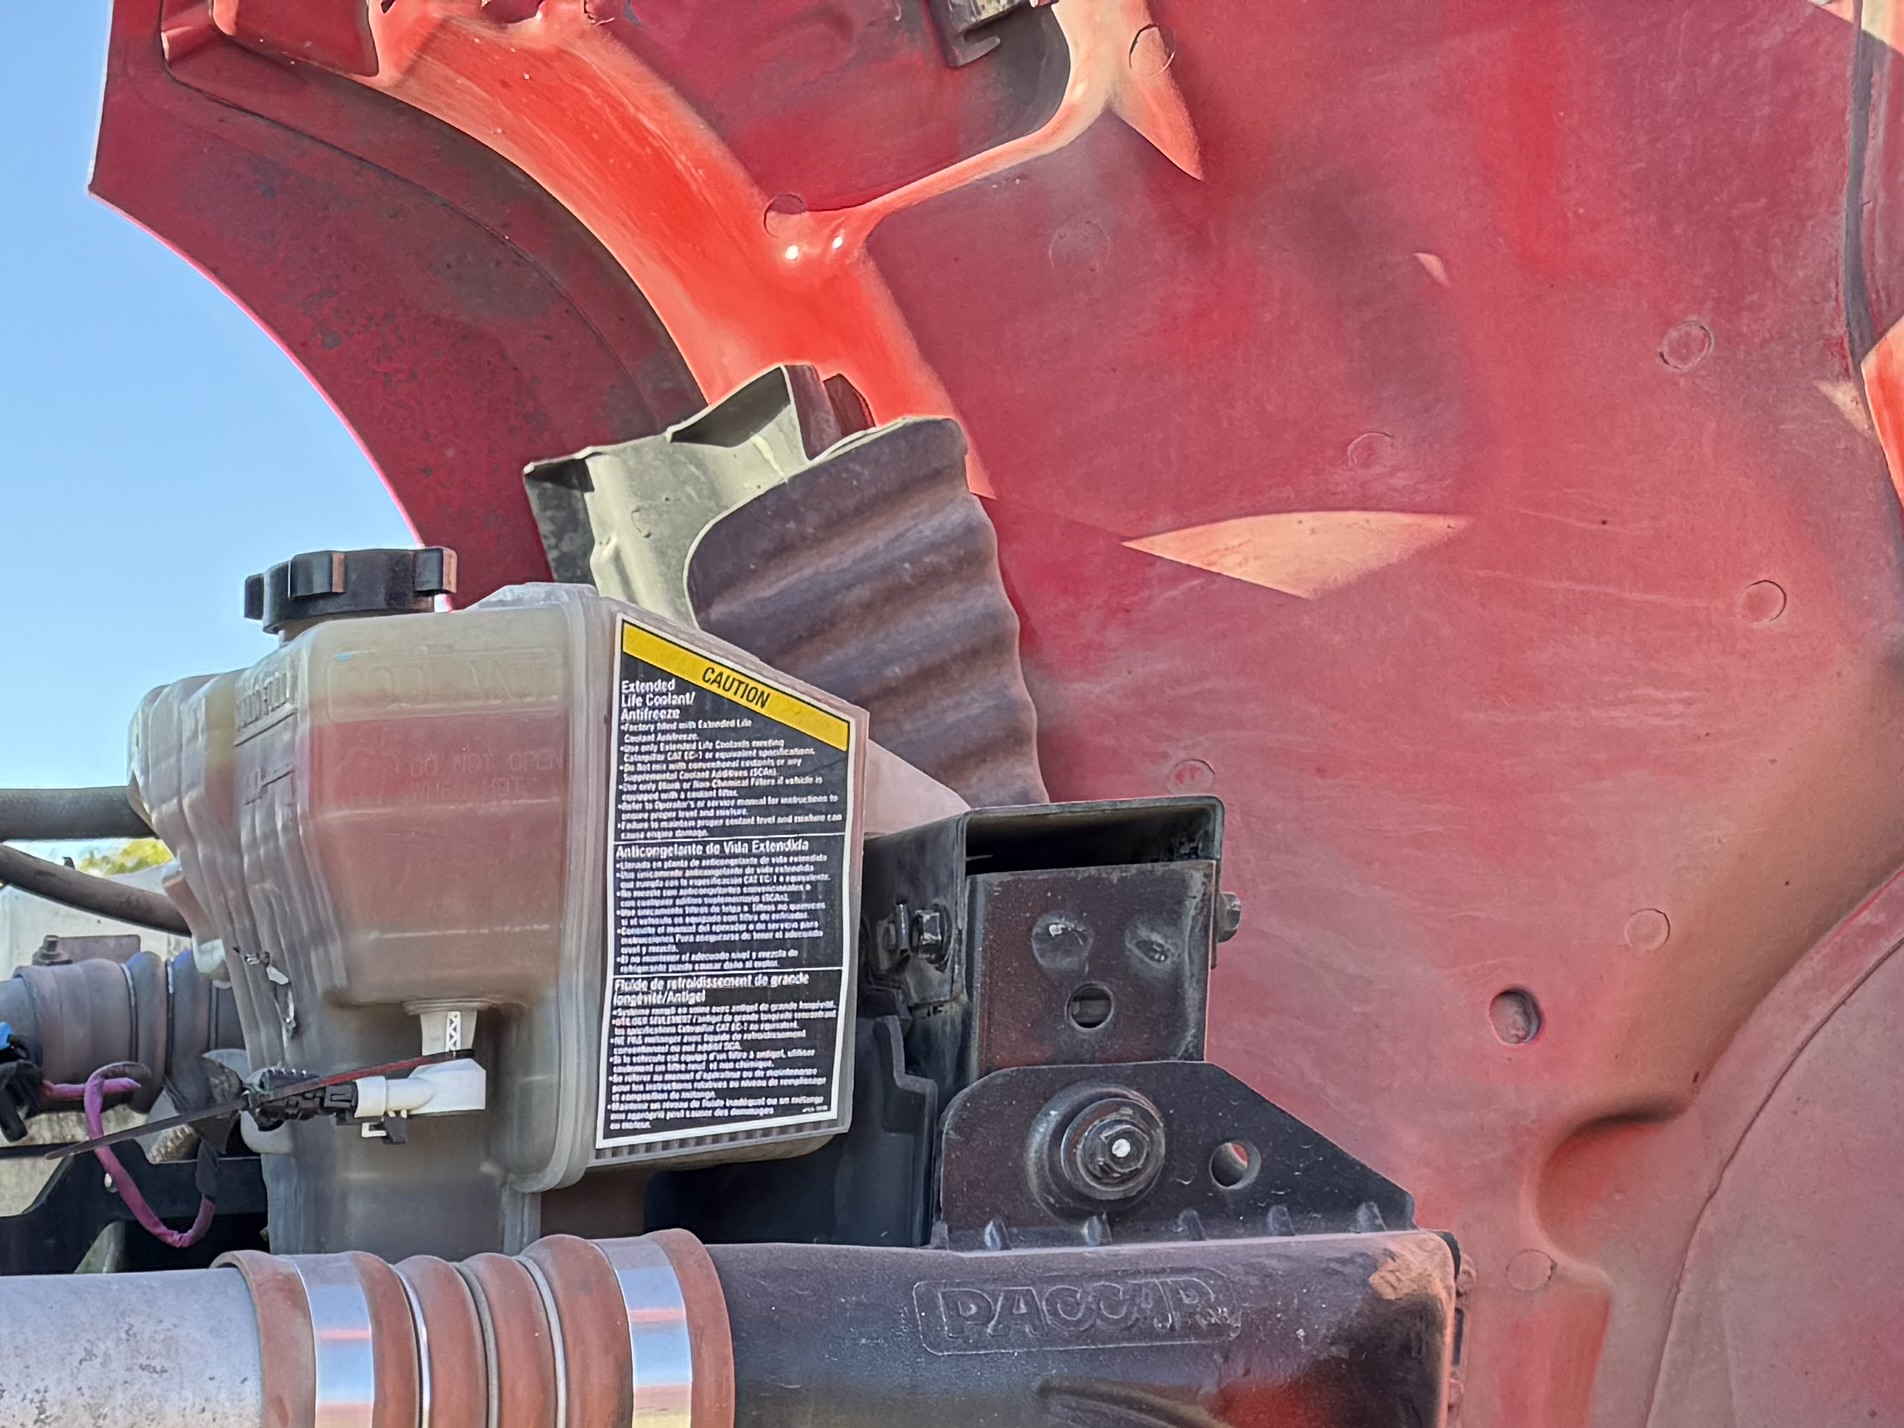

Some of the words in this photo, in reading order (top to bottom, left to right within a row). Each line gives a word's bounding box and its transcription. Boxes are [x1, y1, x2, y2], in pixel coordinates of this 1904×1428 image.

[621, 679, 675, 693] Extended
[702, 667, 771, 709] CAUTION
[621, 694, 644, 707] Life
[646, 692, 695, 706] Coolant/
[621, 707, 680, 721] Antifreeze
[510, 748, 562, 771] OPEN
[616, 845, 702, 859] Anticongelante
[705, 842, 720, 855] de
[723, 840, 748, 854] Vida
[752, 838, 809, 853] Extendida
[650, 978, 664, 991] de
[666, 974, 751, 990] refroidissement
[755, 974, 769, 986] de
[771, 972, 809, 987] grande
[938, 1277, 1217, 1338] PACCAR
